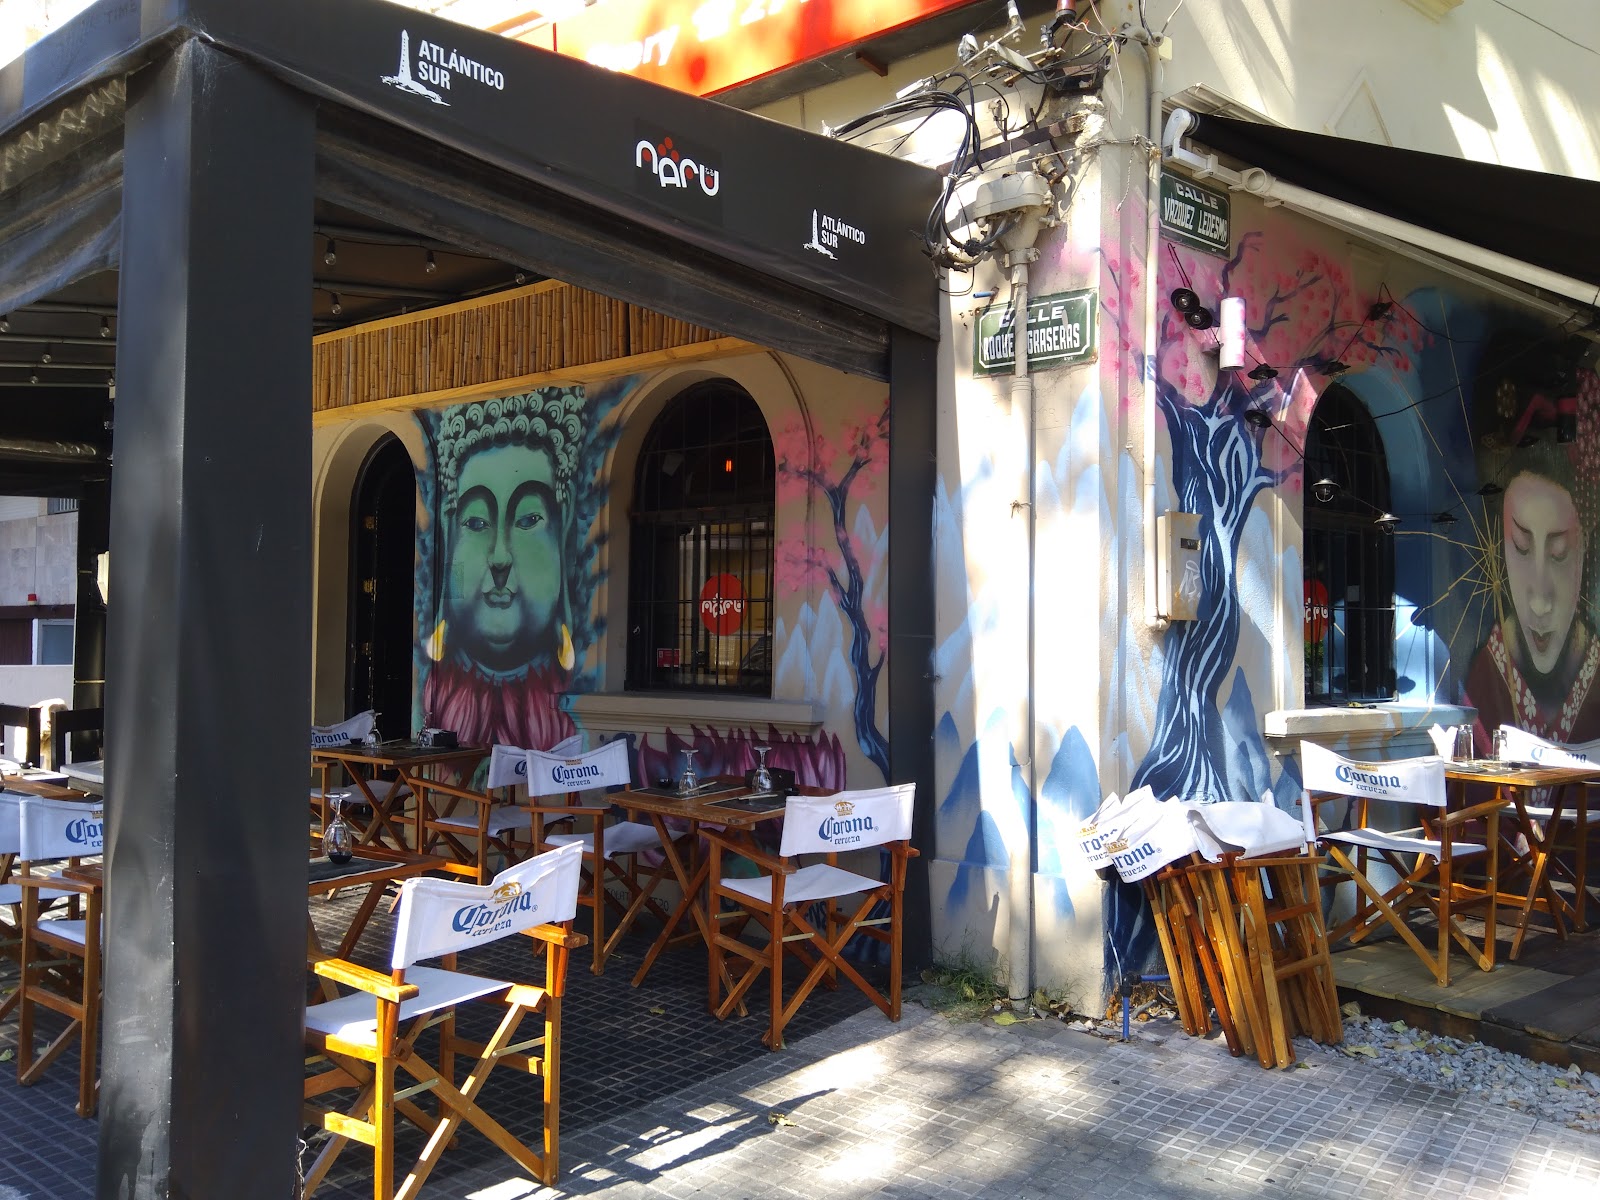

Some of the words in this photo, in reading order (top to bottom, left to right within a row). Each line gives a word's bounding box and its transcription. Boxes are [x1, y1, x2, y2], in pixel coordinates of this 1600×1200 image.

[418, 40, 505, 91] ATLÁNTICO
[418, 61, 451, 90] SUR
[1175, 182, 1219, 210] CALLE
[821, 214, 866, 245] ATLÁNTICO
[821, 229, 839, 249] SUR
[1197, 209, 1228, 243] LEDESMA
[999, 305, 1065, 328] CLLE
[983, 332, 1015, 361] ROQUE
[1026, 322, 1081, 355] GRASERAS
[551, 764, 600, 785] Corona
[1335, 764, 1402, 788] Corona
[818, 815, 874, 843] Corona
[1111, 842, 1156, 869] rona
[451, 891, 532, 935] Corona
